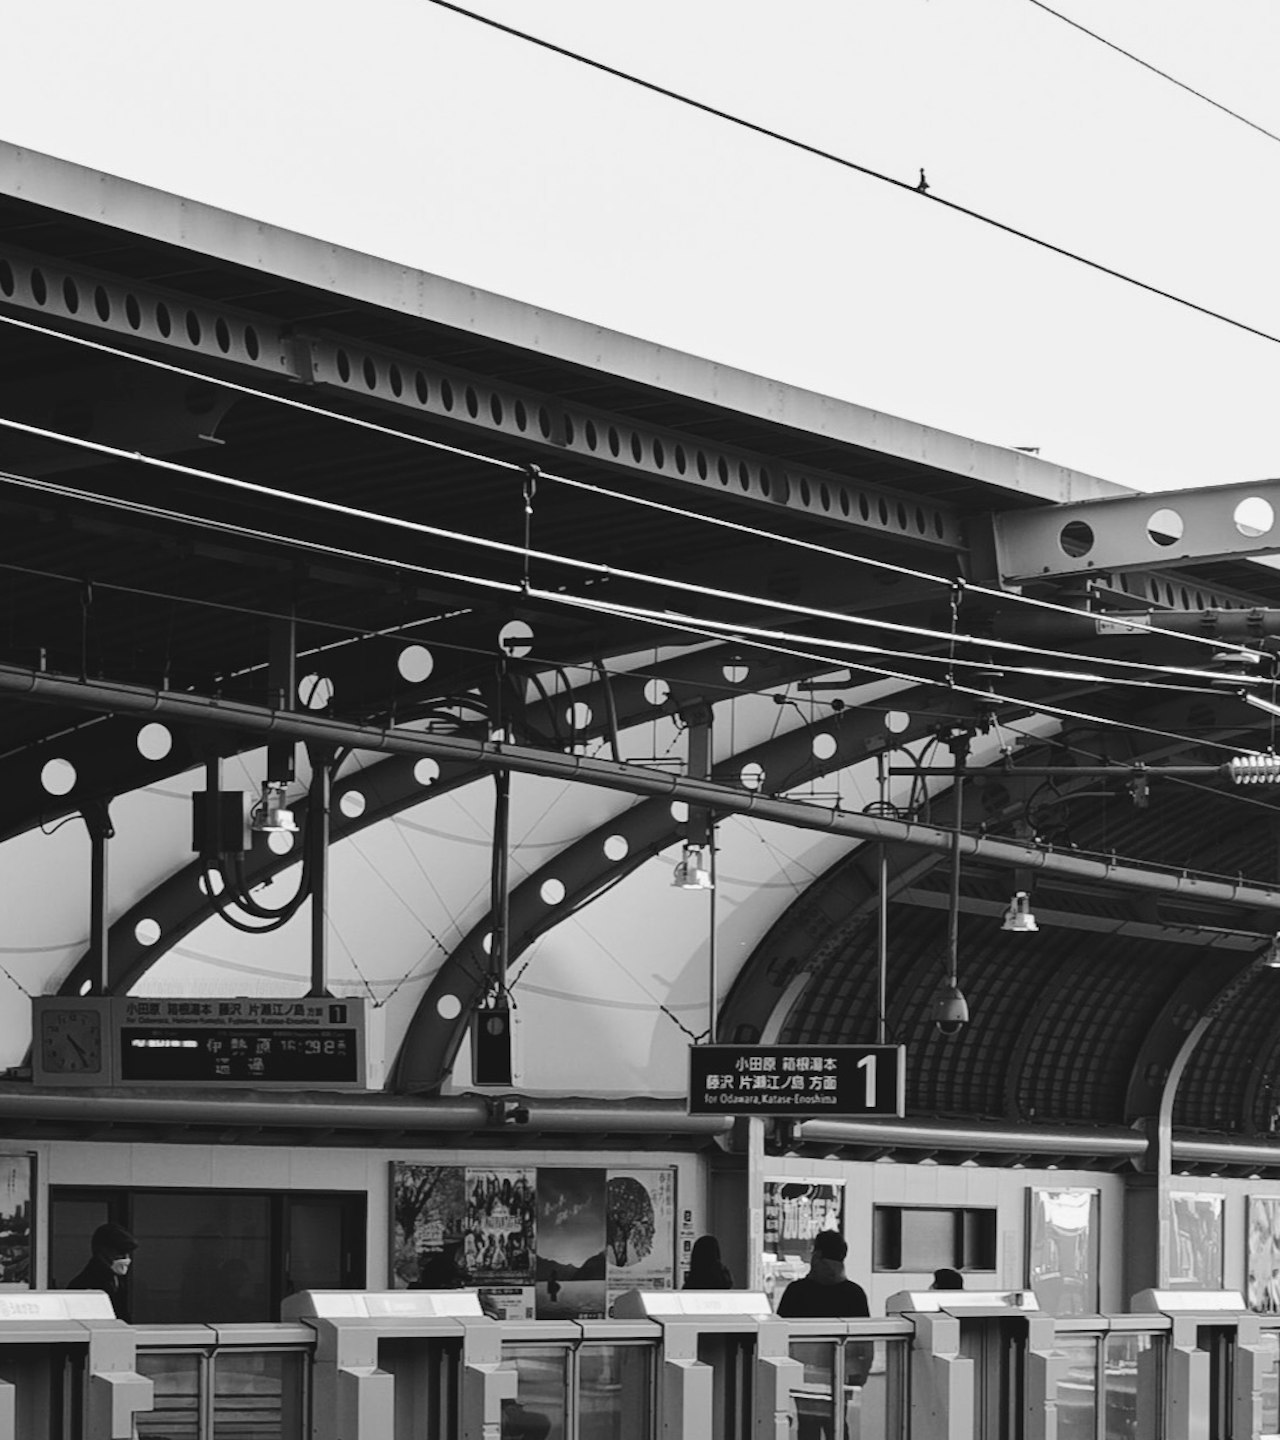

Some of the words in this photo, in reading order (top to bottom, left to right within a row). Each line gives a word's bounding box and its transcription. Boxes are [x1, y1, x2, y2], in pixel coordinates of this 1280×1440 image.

[127, 1003, 160, 1016] 小田原
[167, 1003, 213, 1016] 箱根湯本
[219, 1003, 242, 1016] 藤沢
[249, 1003, 305, 1017] 片瀬江ノ島
[735, 1056, 776, 1072] 小田原
[782, 1056, 837, 1072] 箱根湯本
[706, 1074, 734, 1090] 藤沢
[739, 1074, 805, 1090] 片瀬江ノ島
[809, 1074, 837, 1090] 方面
[856, 1054, 877, 1108] 1
[704, 1093, 718, 1104] for
